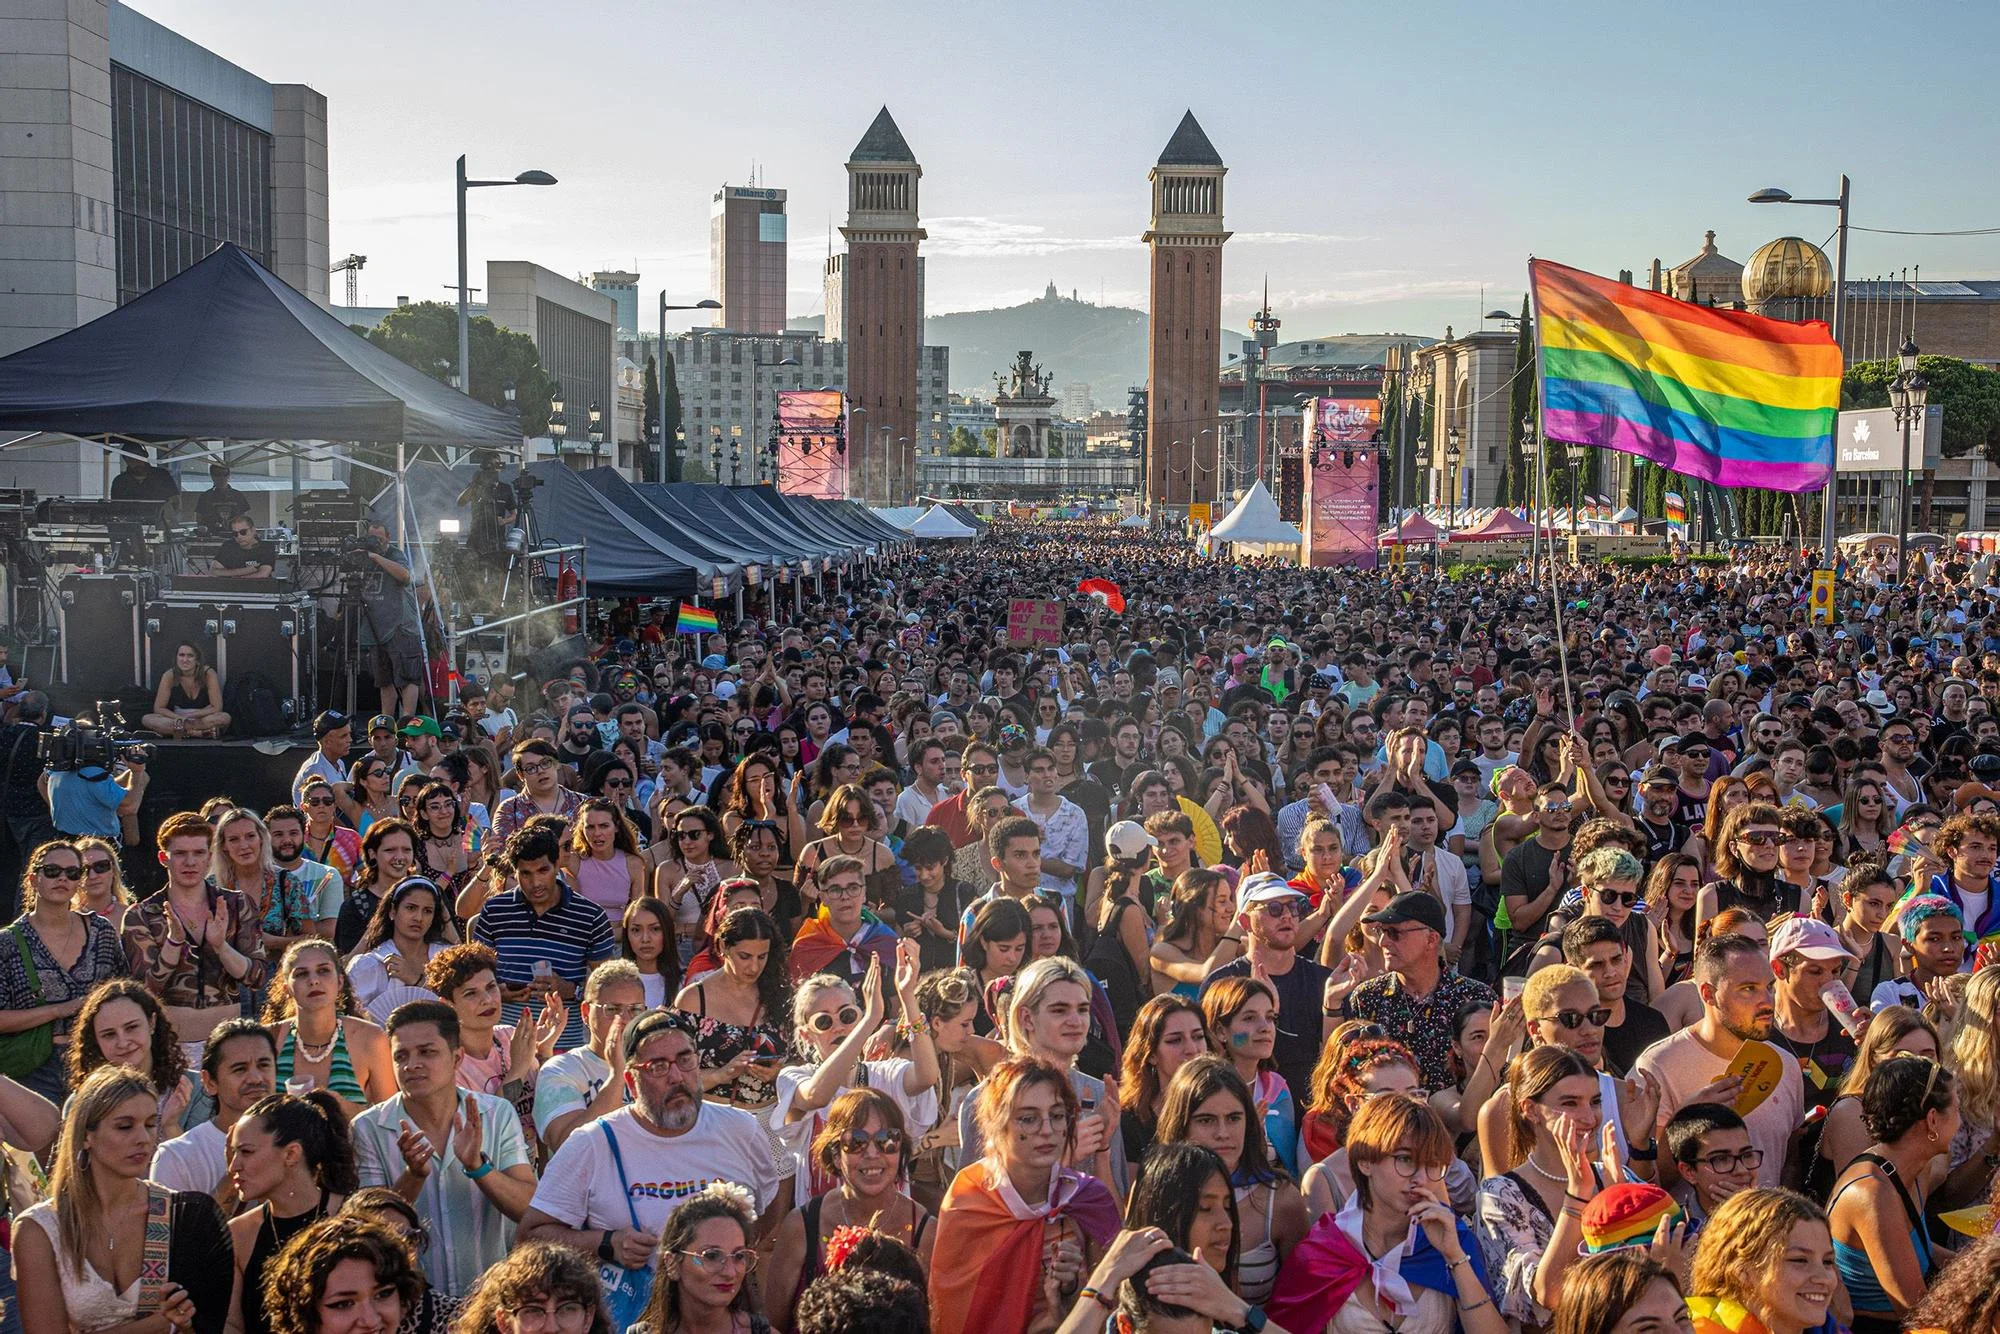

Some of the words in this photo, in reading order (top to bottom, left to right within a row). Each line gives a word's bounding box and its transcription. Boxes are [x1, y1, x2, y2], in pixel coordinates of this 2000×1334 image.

[734, 188, 765, 198] Allianz
[1842, 447, 1853, 461] Fira
[1853, 447, 1880, 461] Barcelona
[1012, 601, 1036, 613] LOVE
[1009, 624, 1027, 640] THE
[628, 1177, 726, 1200] ORGULL
